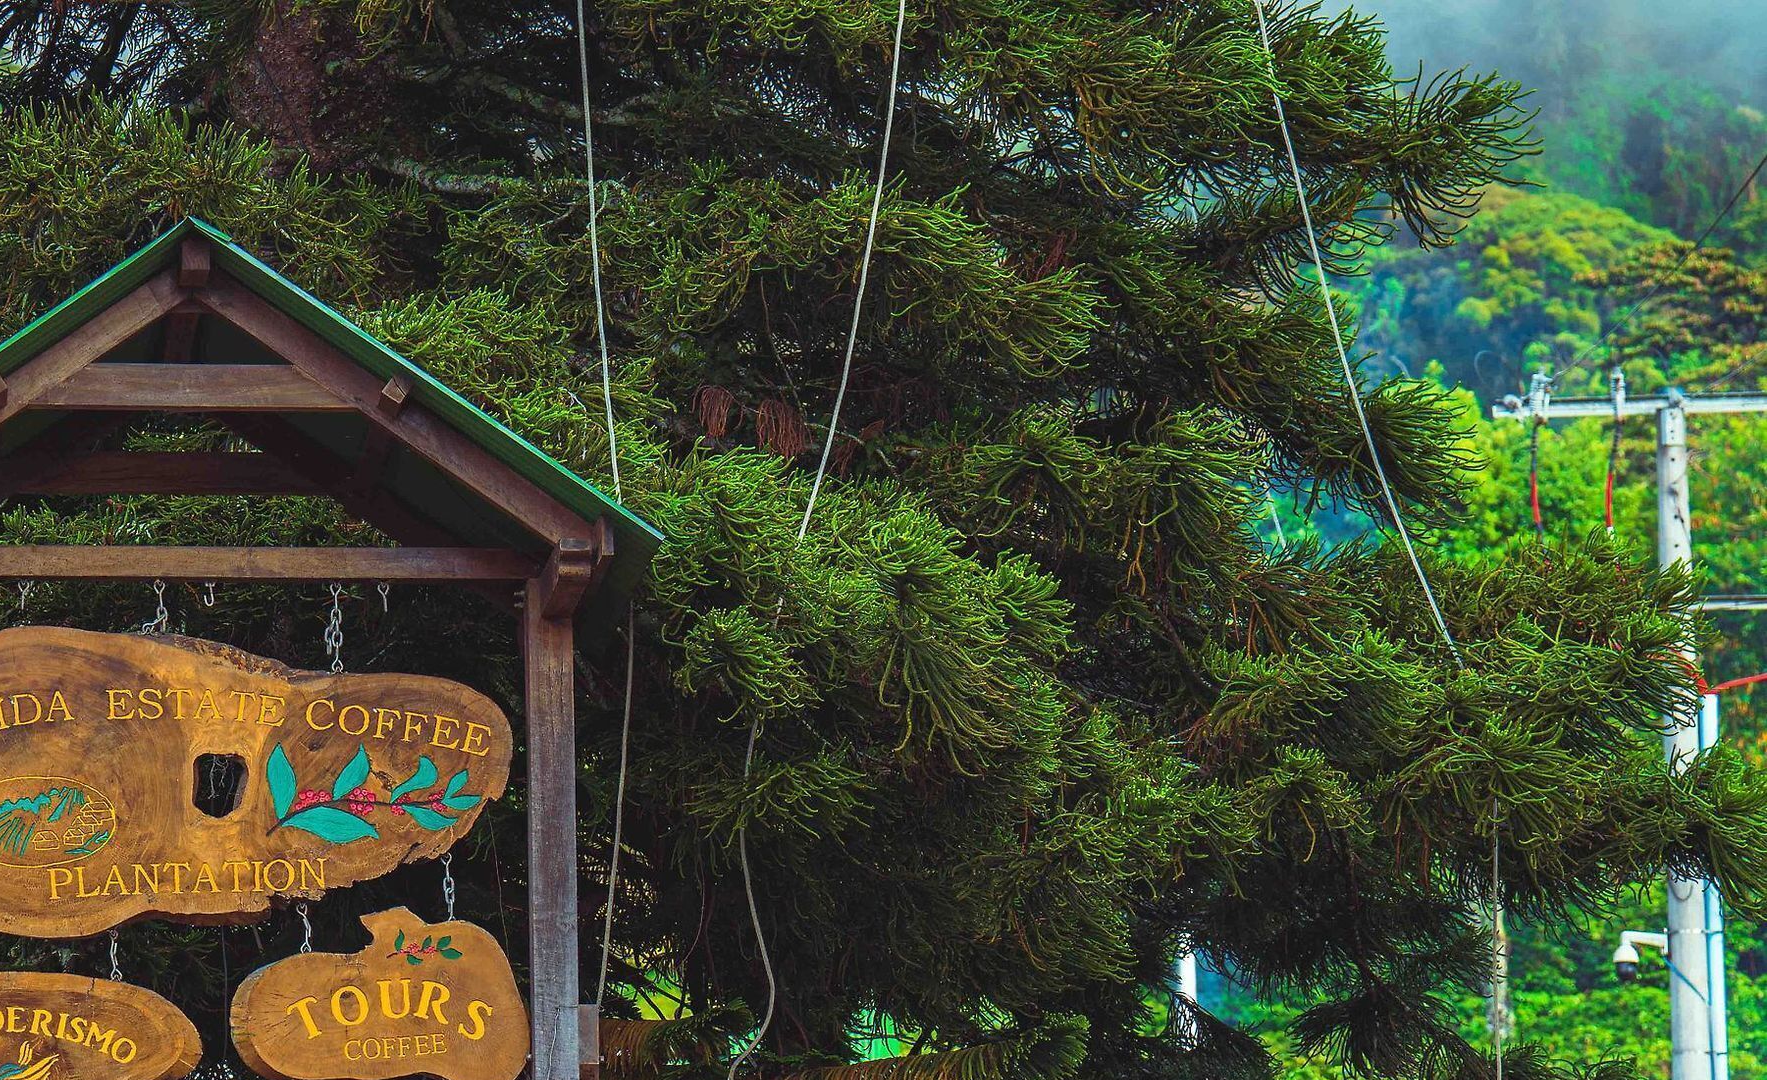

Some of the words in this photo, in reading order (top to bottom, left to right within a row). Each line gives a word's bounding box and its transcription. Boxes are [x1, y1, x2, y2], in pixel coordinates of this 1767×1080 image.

[106, 688, 287, 727] ESTATE
[305, 698, 492, 758] COFFEE
[47, 857, 329, 900] PLANTATION
[286, 978, 493, 1041] TOURS
[344, 1033, 448, 1061] COFFEE
